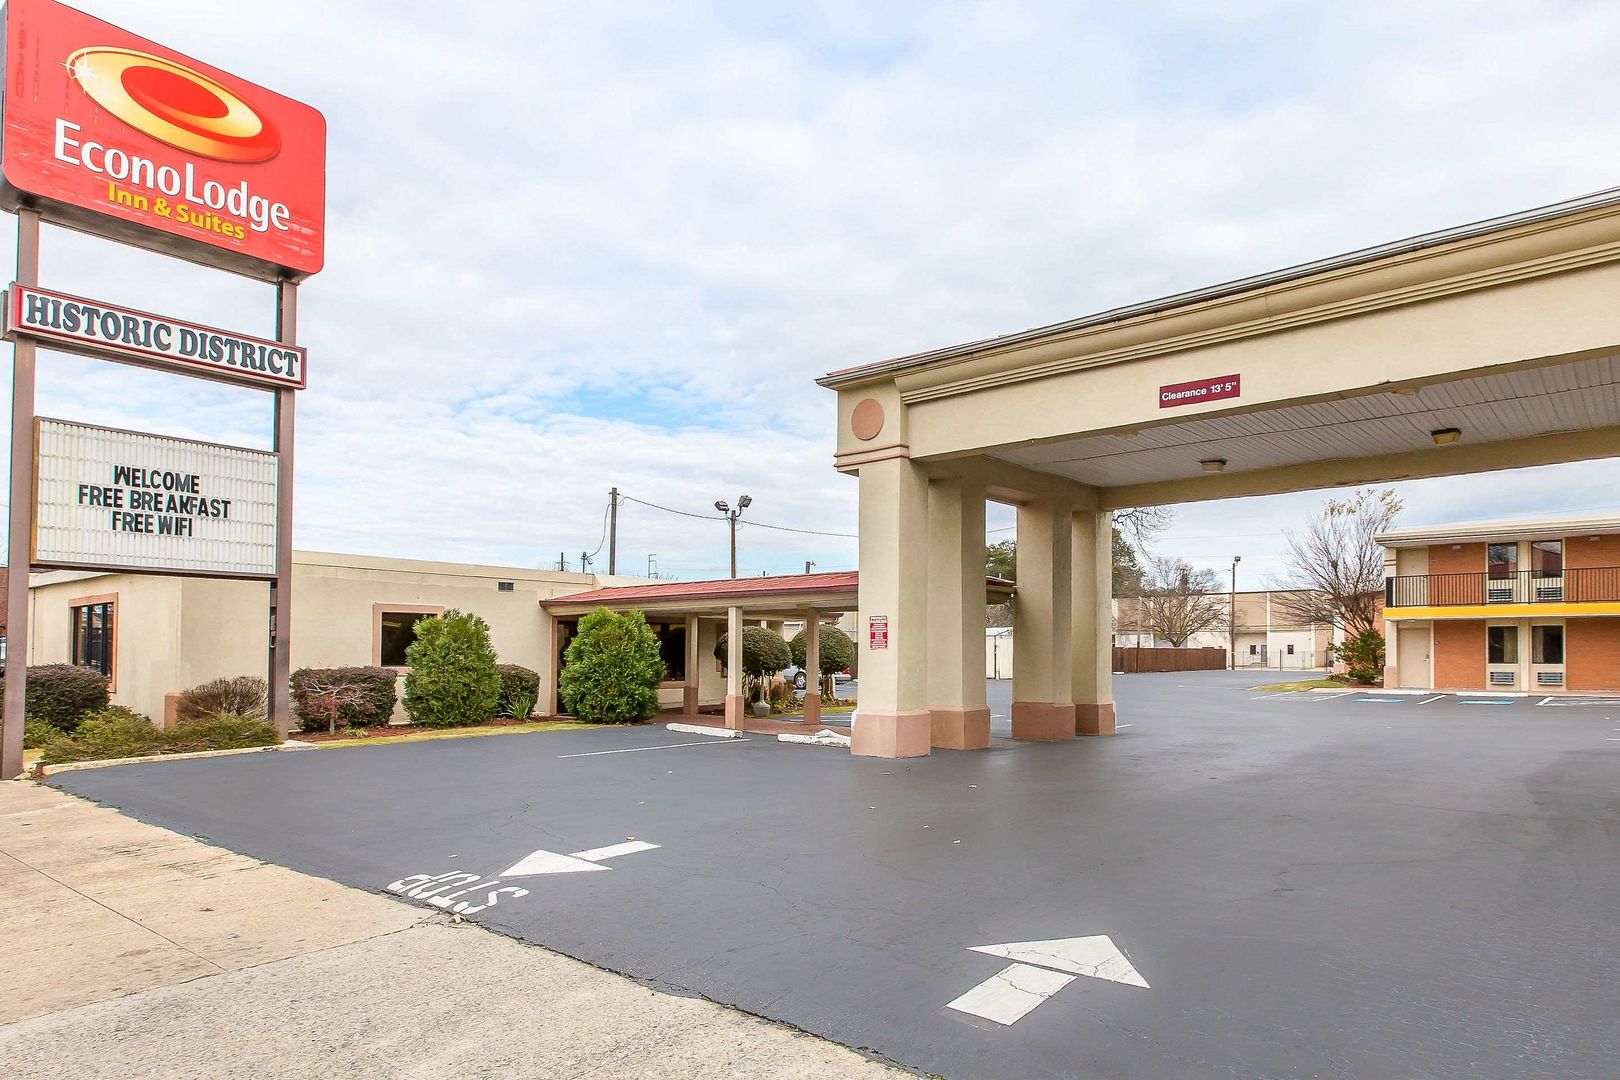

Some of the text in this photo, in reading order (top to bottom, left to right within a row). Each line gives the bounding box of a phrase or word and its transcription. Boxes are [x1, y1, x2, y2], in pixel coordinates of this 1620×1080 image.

[108, 181, 246, 240] Inn & Suites
[26, 294, 299, 377] HISTORIC DISTRICT
[1162, 388, 1207, 401] Clearance
[114, 465, 200, 494] WELCOME
[79, 484, 231, 519] FREE BREAKFAST
[112, 511, 193, 537] FREE WIFI
[386, 870, 530, 915] STOP
